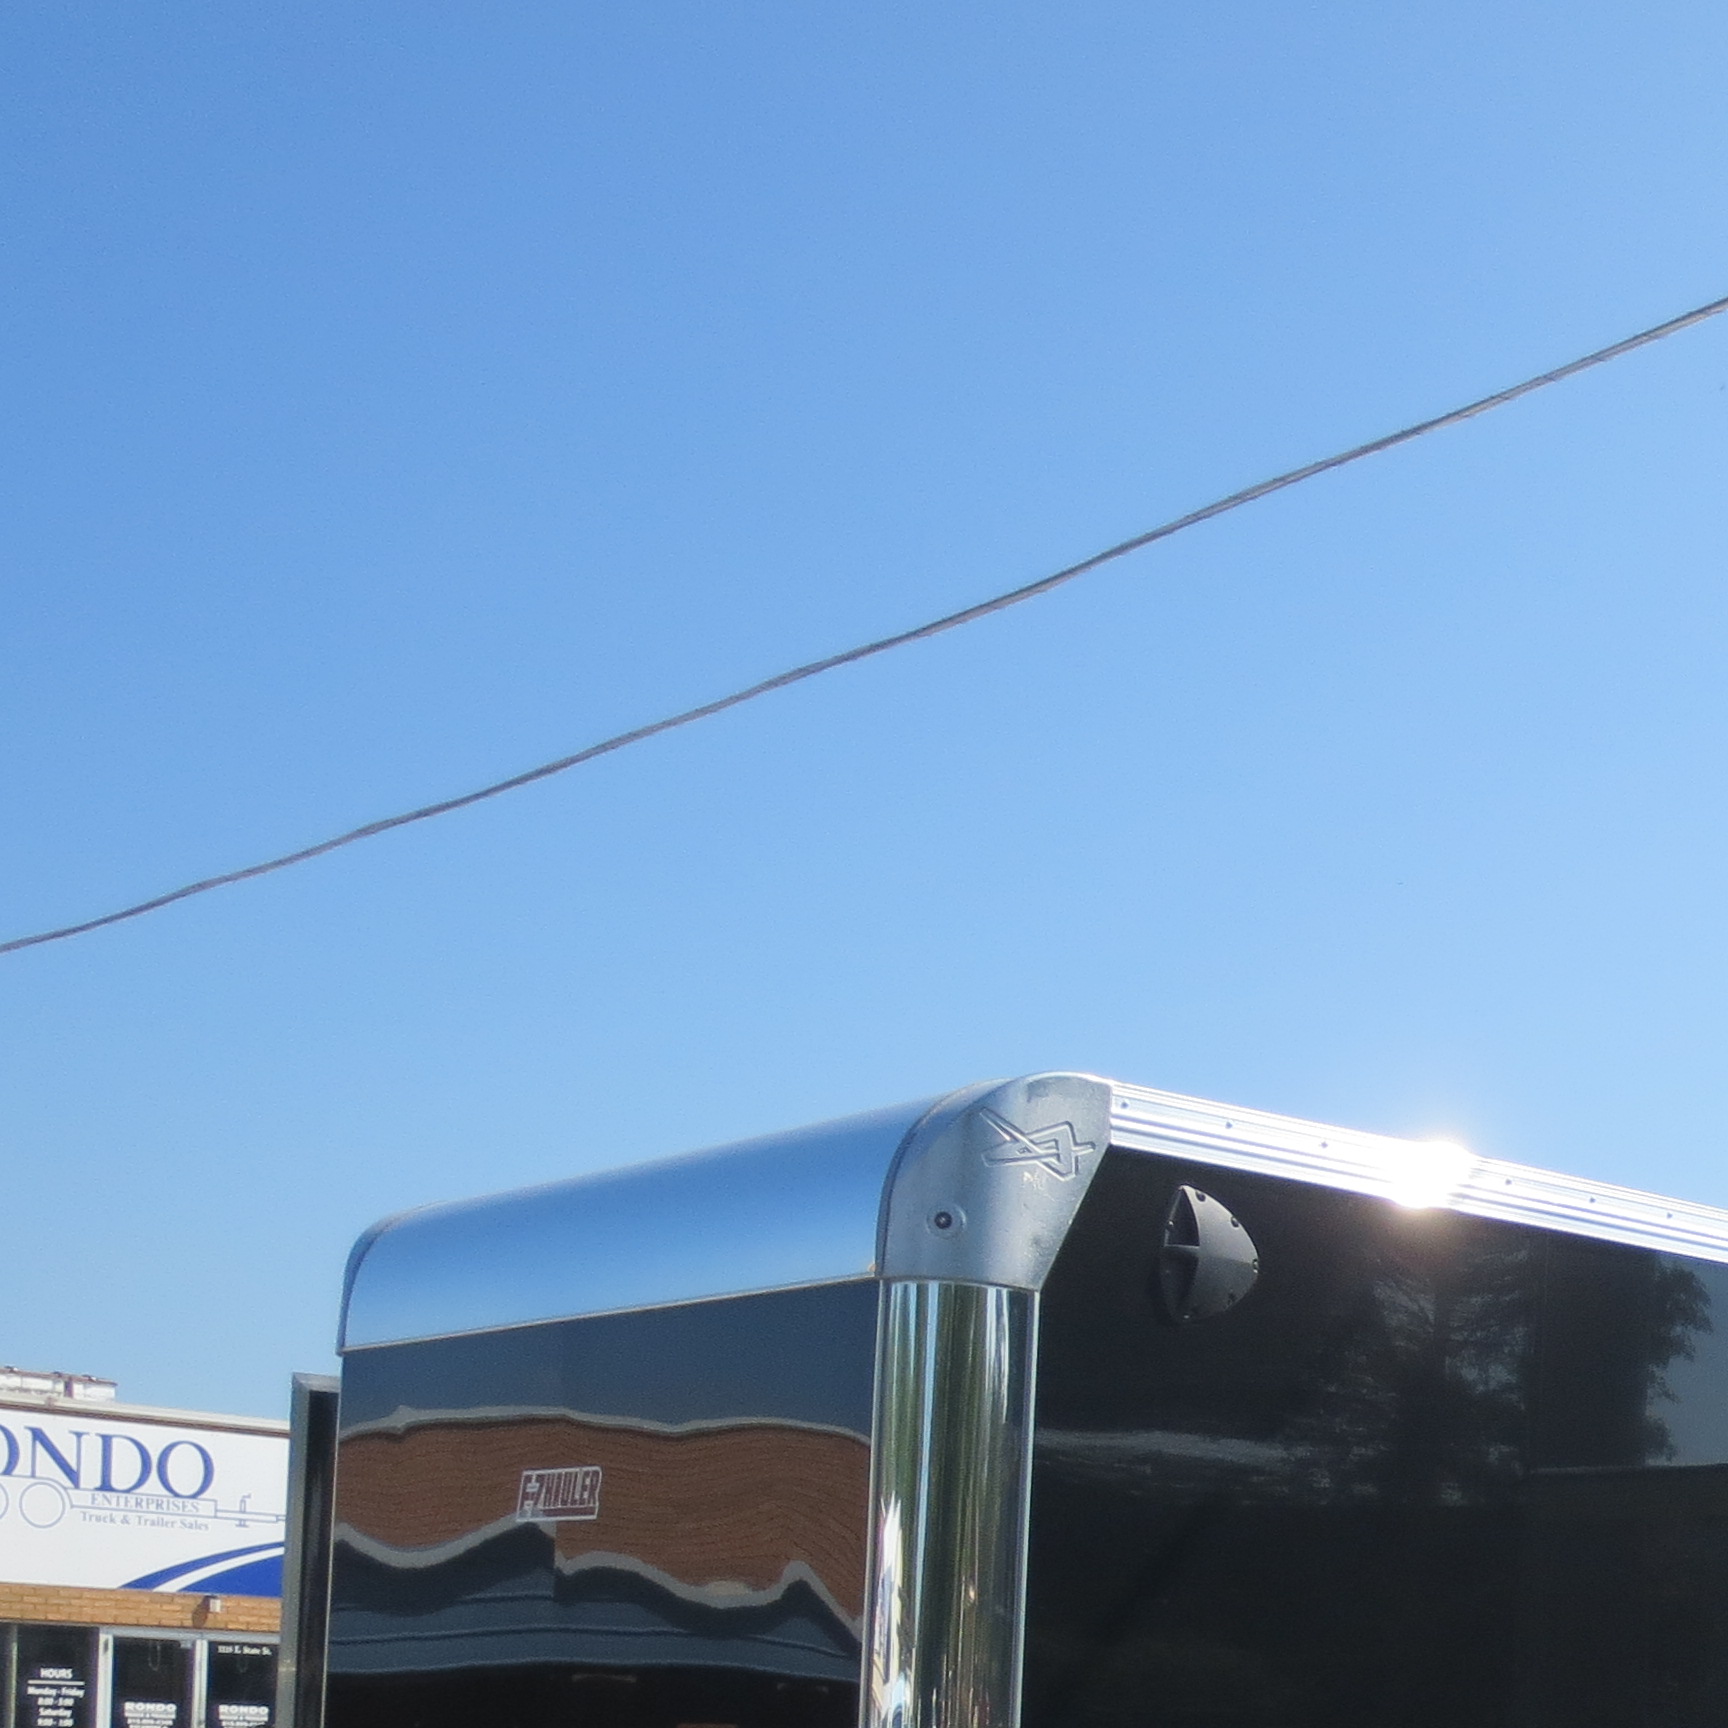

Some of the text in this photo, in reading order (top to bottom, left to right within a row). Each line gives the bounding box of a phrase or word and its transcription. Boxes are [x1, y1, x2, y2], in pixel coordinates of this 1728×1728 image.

[90, 1492, 200, 1514] ENTERPRISES
[79, 1511, 210, 1532] Truck & Trailer Sales
[40, 1667, 73, 1679] HOURS
[124, 1701, 177, 1712] RONDO
[218, 1704, 270, 1715] RONDO
